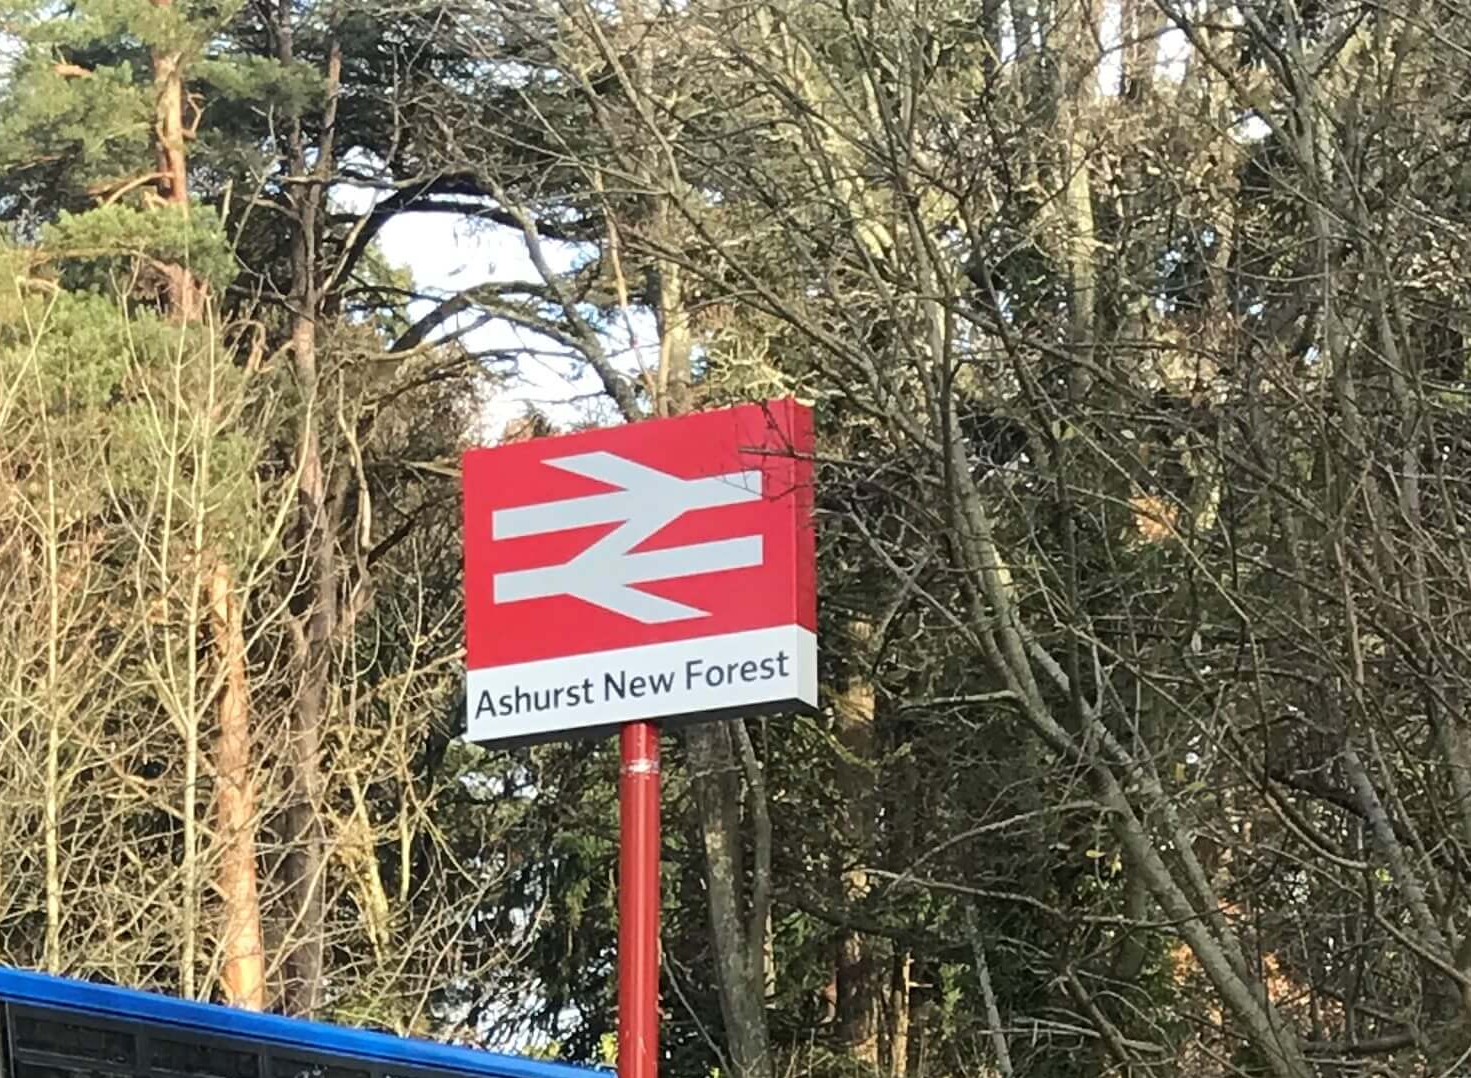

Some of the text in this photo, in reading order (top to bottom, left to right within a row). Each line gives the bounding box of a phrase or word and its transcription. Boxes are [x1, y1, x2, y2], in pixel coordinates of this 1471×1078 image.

[475, 651, 790, 719] Ashurst New Forest
